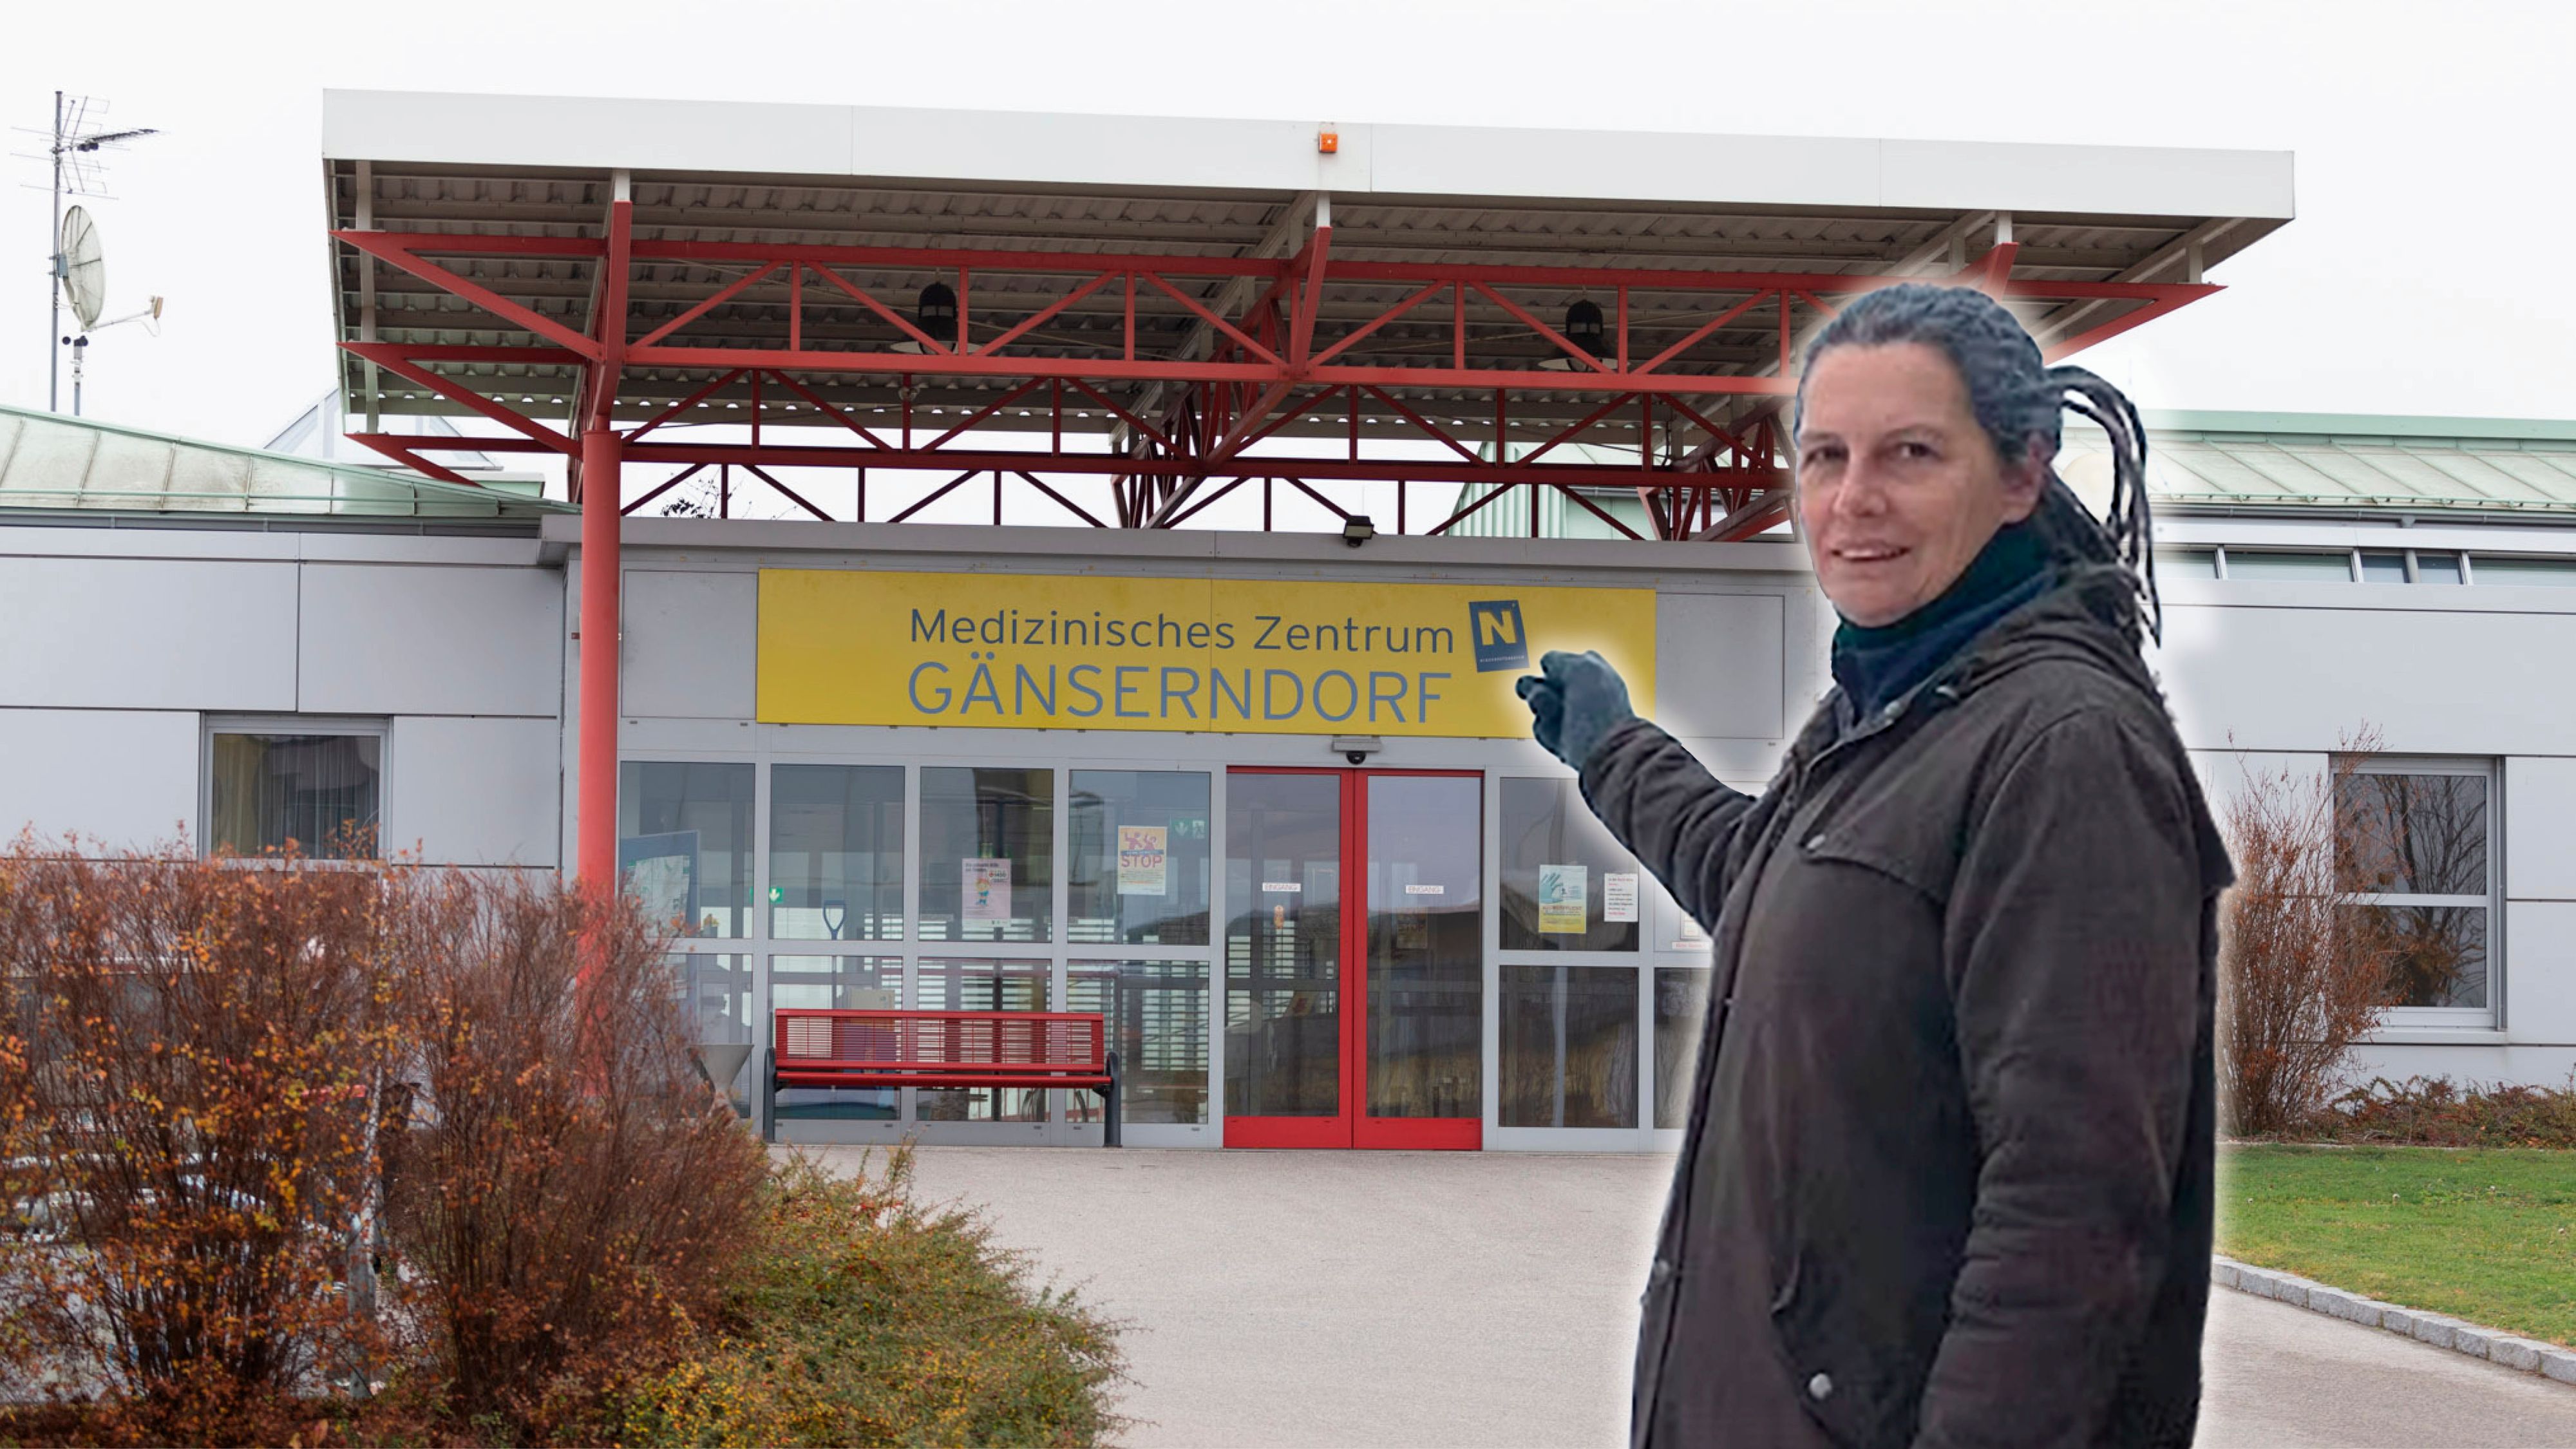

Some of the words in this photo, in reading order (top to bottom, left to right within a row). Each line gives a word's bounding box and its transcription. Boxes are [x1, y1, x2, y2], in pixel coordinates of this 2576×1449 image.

[911, 608, 1235, 650] Medizinisches
[1253, 615, 1454, 654] Zentrum
[1478, 610, 1517, 646] N
[908, 651, 1453, 723] GÄNSERNDORF
[1121, 855, 1162, 867] STOP
